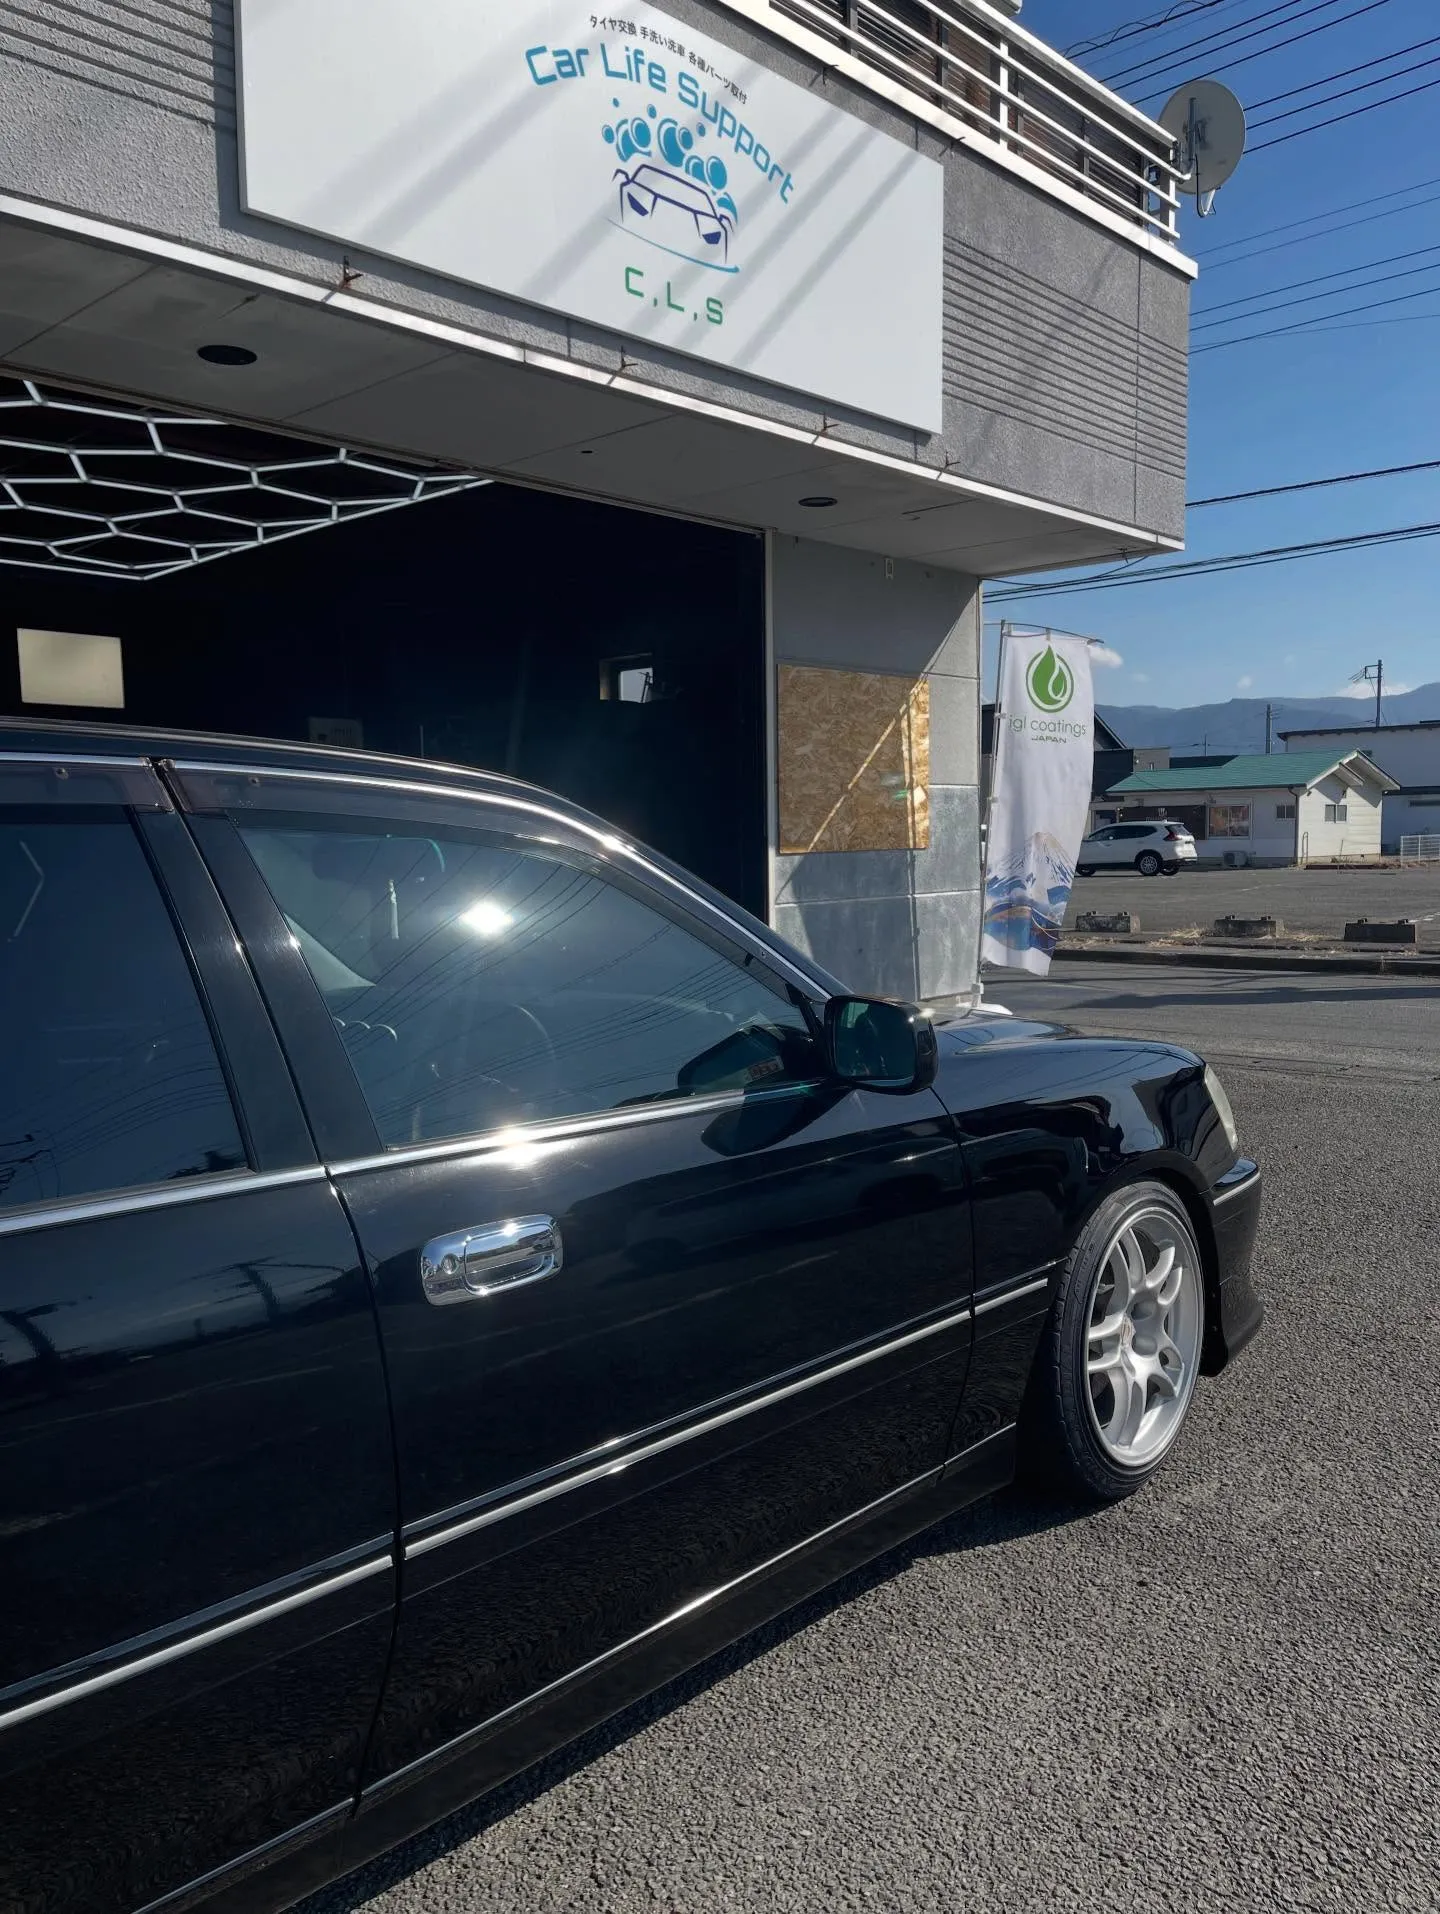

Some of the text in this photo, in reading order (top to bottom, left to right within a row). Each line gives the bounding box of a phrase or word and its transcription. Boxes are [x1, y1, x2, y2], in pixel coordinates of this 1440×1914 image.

[589, 15, 638, 36] タイヤ交換
[640, 26, 685, 56] 手洗い洗車
[525, 43, 794, 204] Car Life Support
[1009, 714, 1086, 737] igl coatings
[1031, 735, 1067, 743] JAPAN
